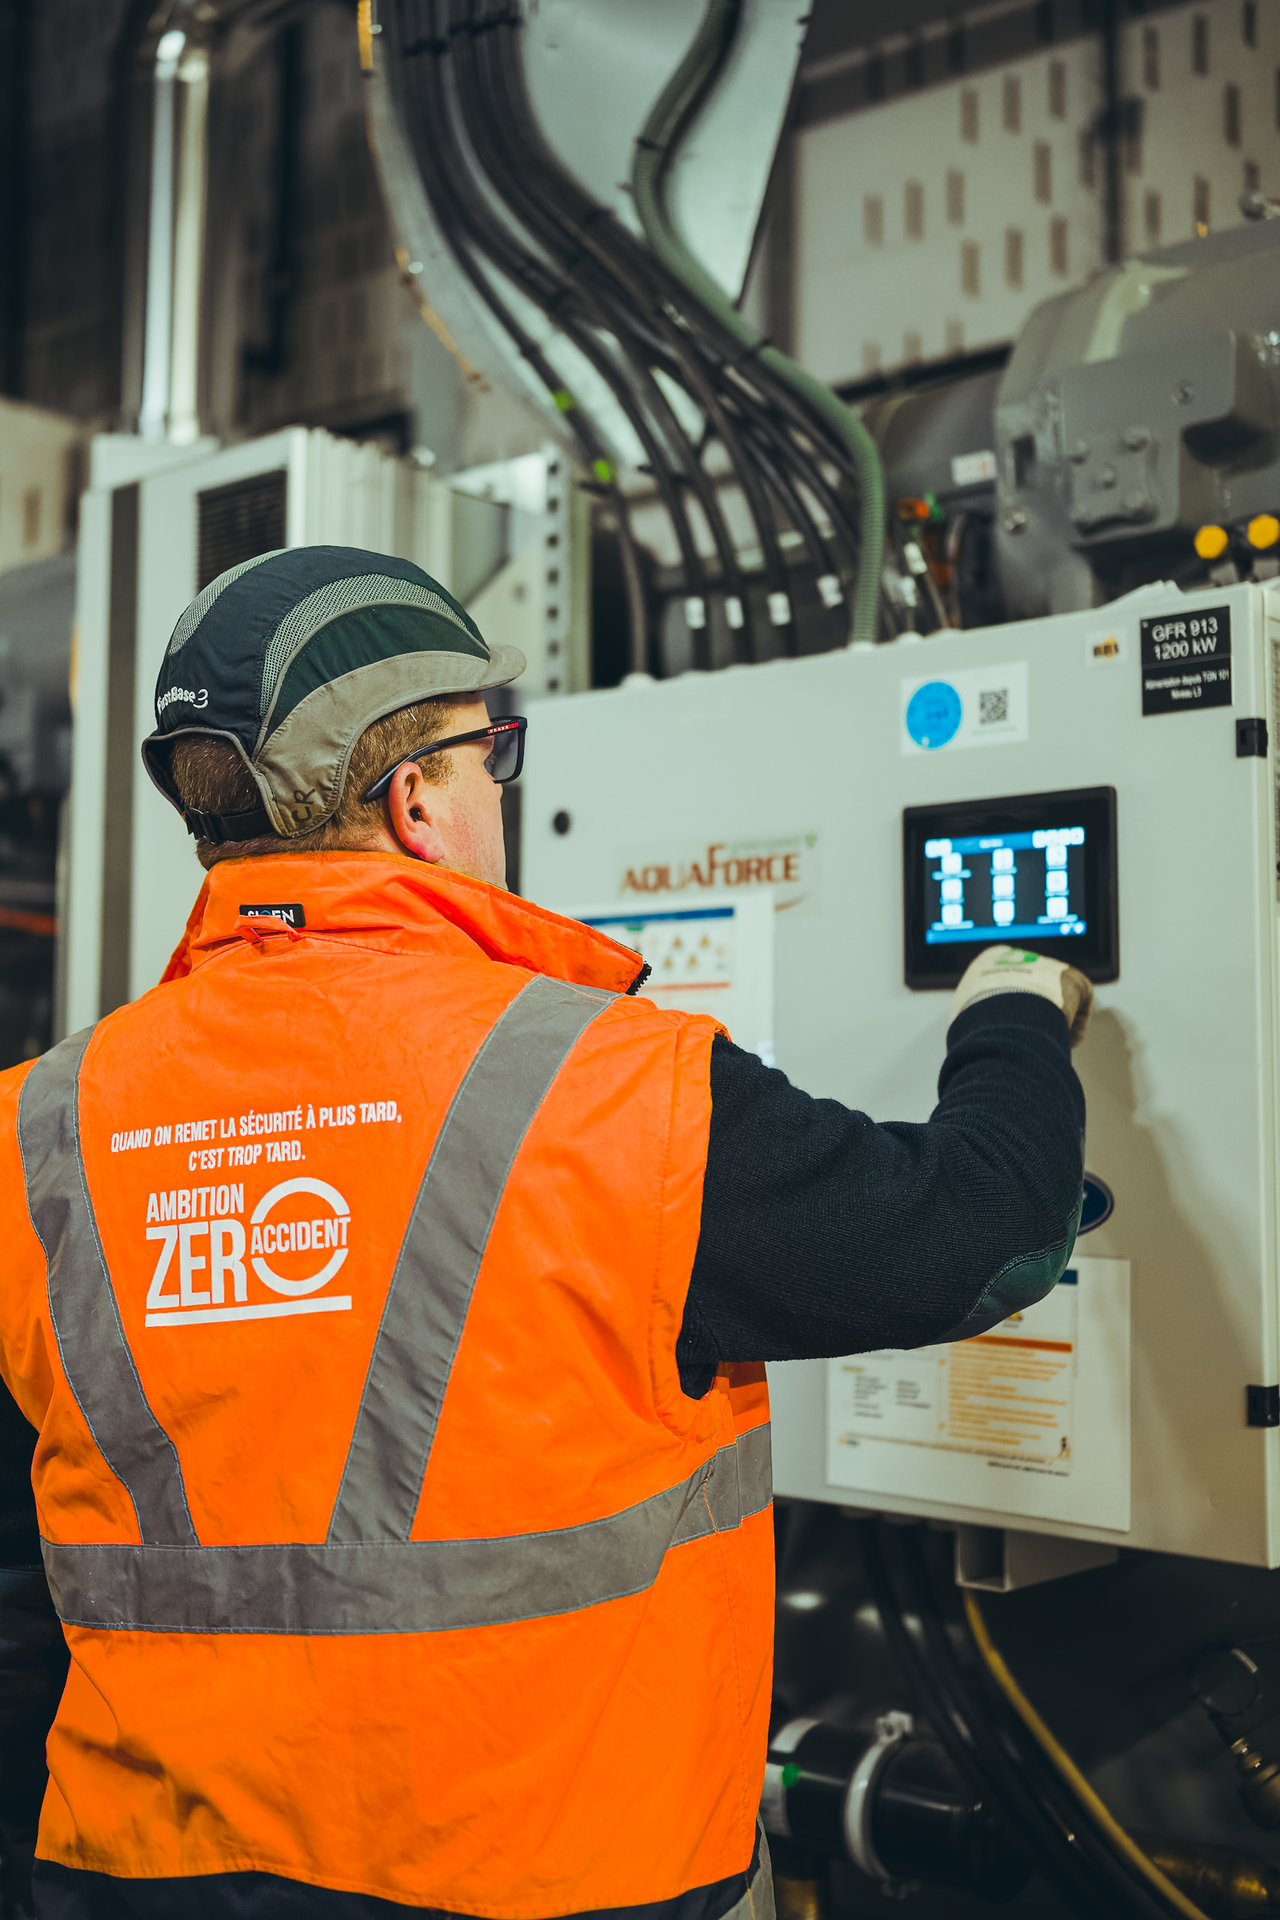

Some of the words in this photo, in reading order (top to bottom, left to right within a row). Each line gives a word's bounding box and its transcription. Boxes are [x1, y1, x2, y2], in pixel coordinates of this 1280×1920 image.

[1152, 621, 1187, 642] GFR
[1189, 616, 1218, 637] 913
[1153, 640, 1189, 660] 1200
[1192, 635, 1217, 655] kW
[111, 1129, 151, 1152] QUAND
[154, 1126, 171, 1146] ON
[174, 1119, 217, 1143] REMET
[220, 1117, 237, 1138] LA
[240, 1105, 302, 1136] SÉCURITÉ
[305, 1104, 317, 1129] À
[319, 1105, 355, 1128] PLUS
[359, 1101, 402, 1124] TARD,
[188, 1148, 225, 1171] C'EST
[227, 1144, 262, 1167] TROP
[266, 1140, 305, 1162] TARD.
[146, 1183, 244, 1223] AMBITION
[250, 1217, 351, 1254] ACCIDENT
